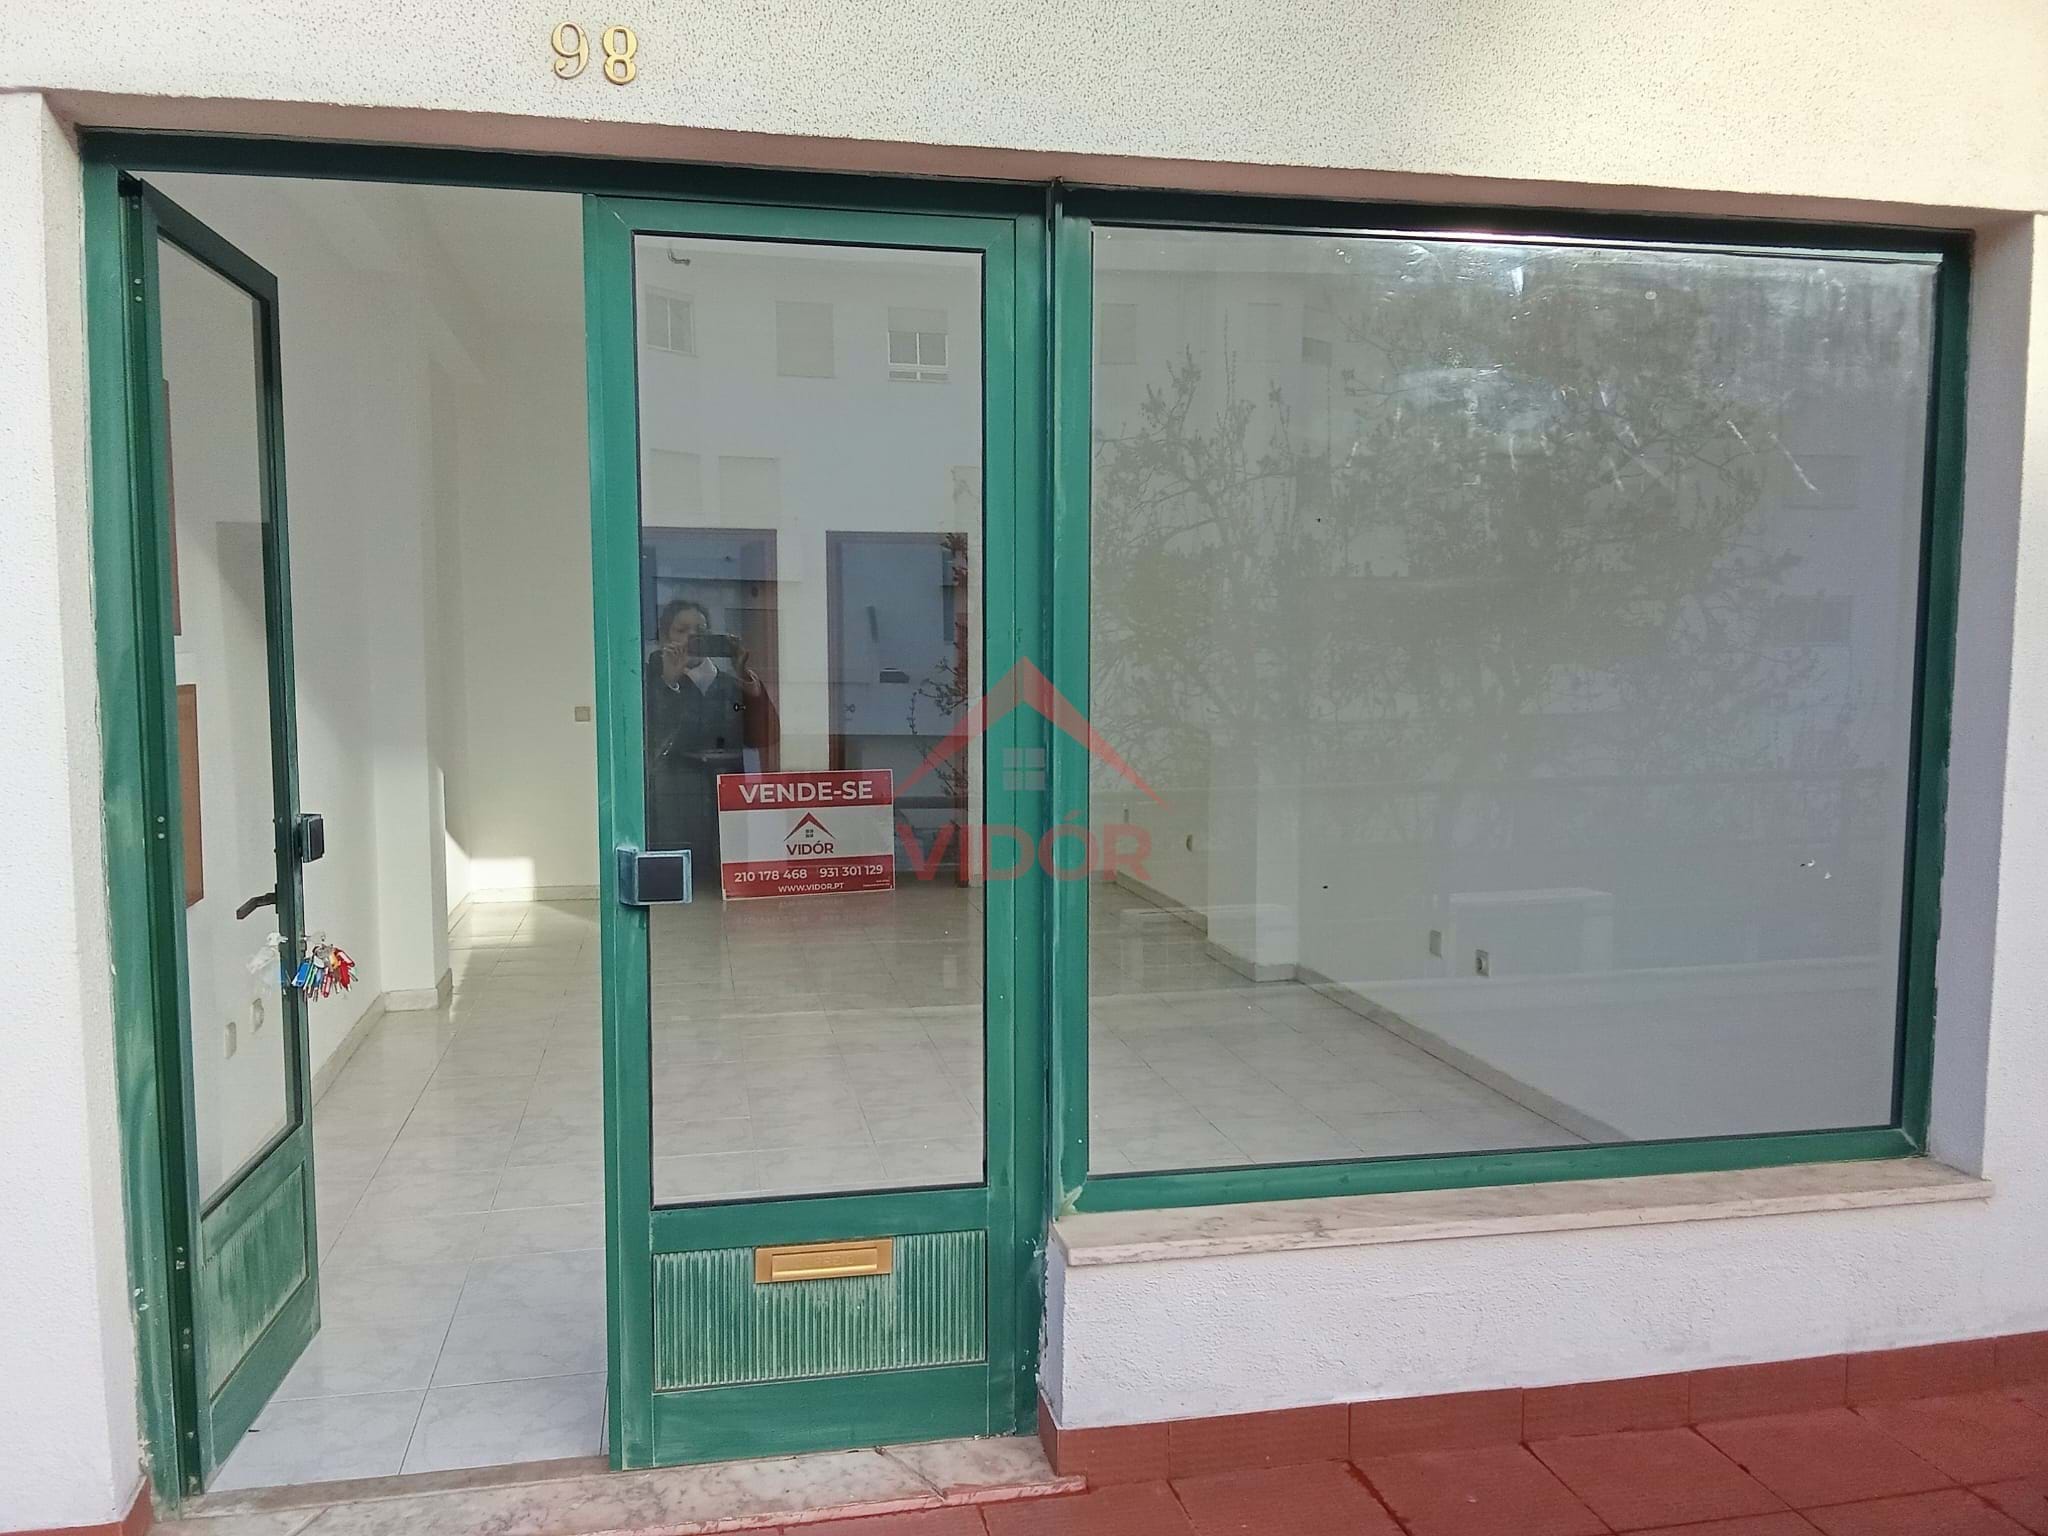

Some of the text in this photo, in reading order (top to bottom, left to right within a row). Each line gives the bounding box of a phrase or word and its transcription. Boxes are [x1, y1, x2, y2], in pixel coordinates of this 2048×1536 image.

[551, 22, 638, 85] 98
[739, 780, 873, 803] VENDE-SE
[786, 840, 834, 855] VIDÓR
[734, 868, 808, 882] 210 178 468
[820, 864, 883, 878] 931 301 129
[778, 882, 845, 893] WWW.VIDOR.PT
